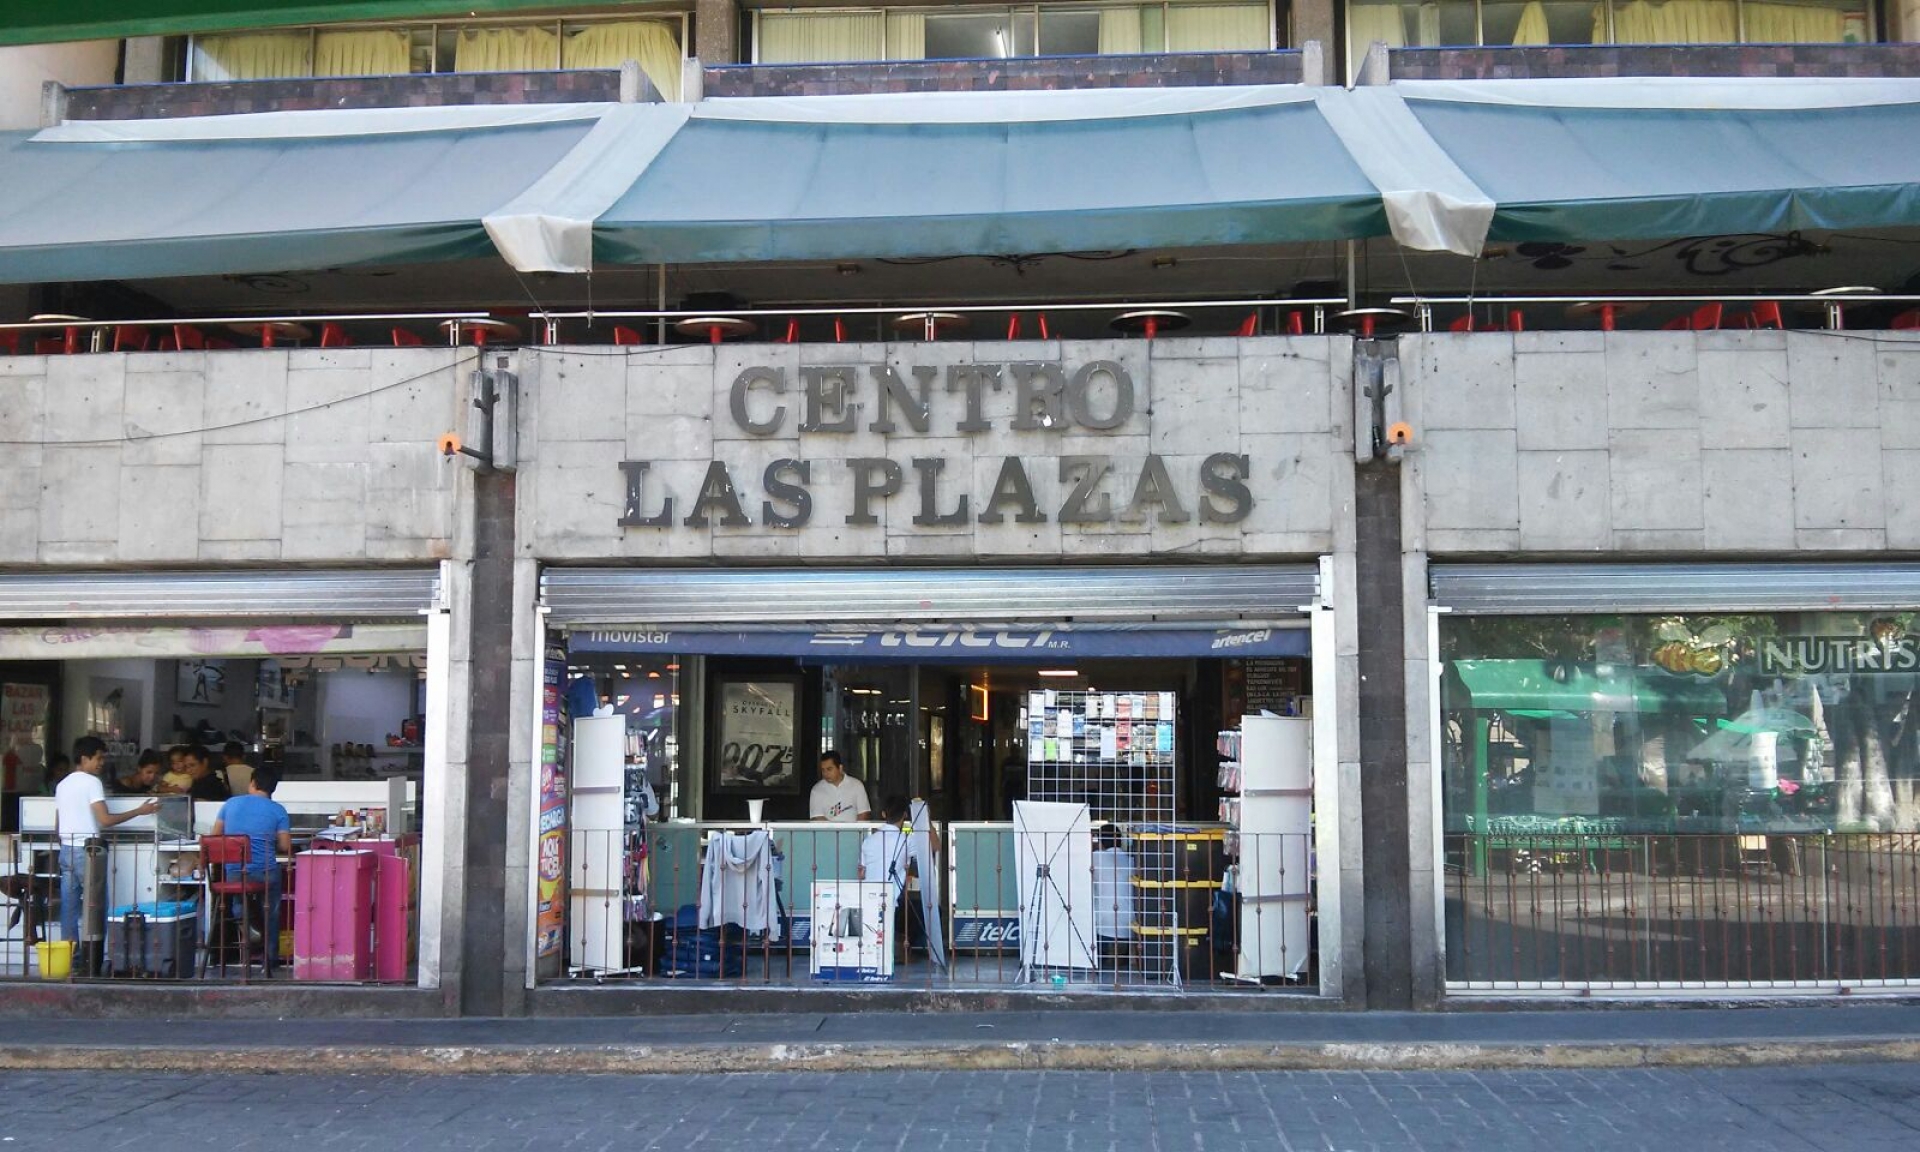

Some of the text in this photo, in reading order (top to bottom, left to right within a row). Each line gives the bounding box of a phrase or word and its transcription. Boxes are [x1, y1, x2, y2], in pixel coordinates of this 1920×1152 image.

[729, 359, 1135, 435] CENTRO
[617, 452, 1253, 529] LAS PLAZAS
[1766, 640, 1920, 670] NUTRIS
[733, 706, 790, 717] SKYFALL
[723, 742, 787, 779] 007
[979, 921, 1020, 942] telc
